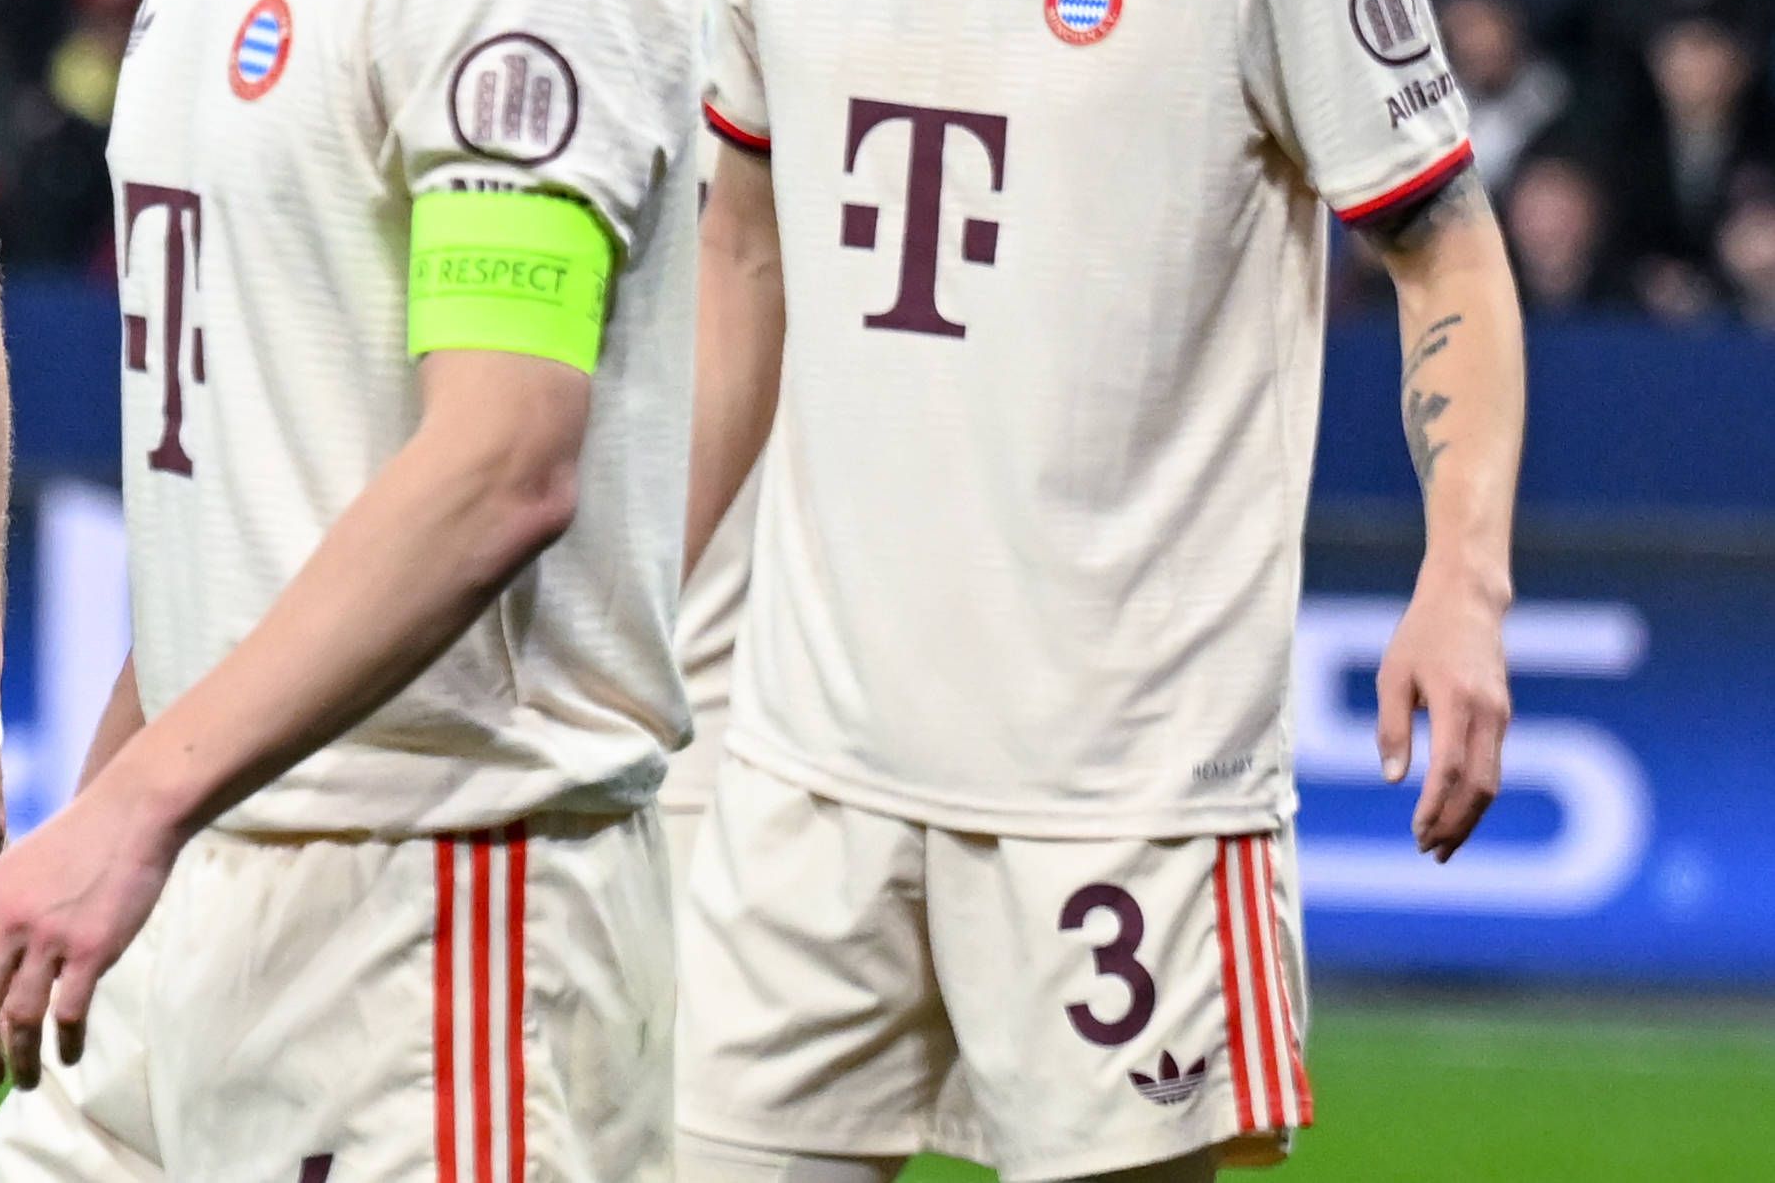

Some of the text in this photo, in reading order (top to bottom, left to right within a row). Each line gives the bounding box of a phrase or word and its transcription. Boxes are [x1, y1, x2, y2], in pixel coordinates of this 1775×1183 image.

[1386, 71, 1454, 129] Allian
[439, 257, 568, 294] RESPECT
[840, 97, 1008, 339] T
[123, 181, 205, 478] T
[1058, 882, 1156, 1048] 3
